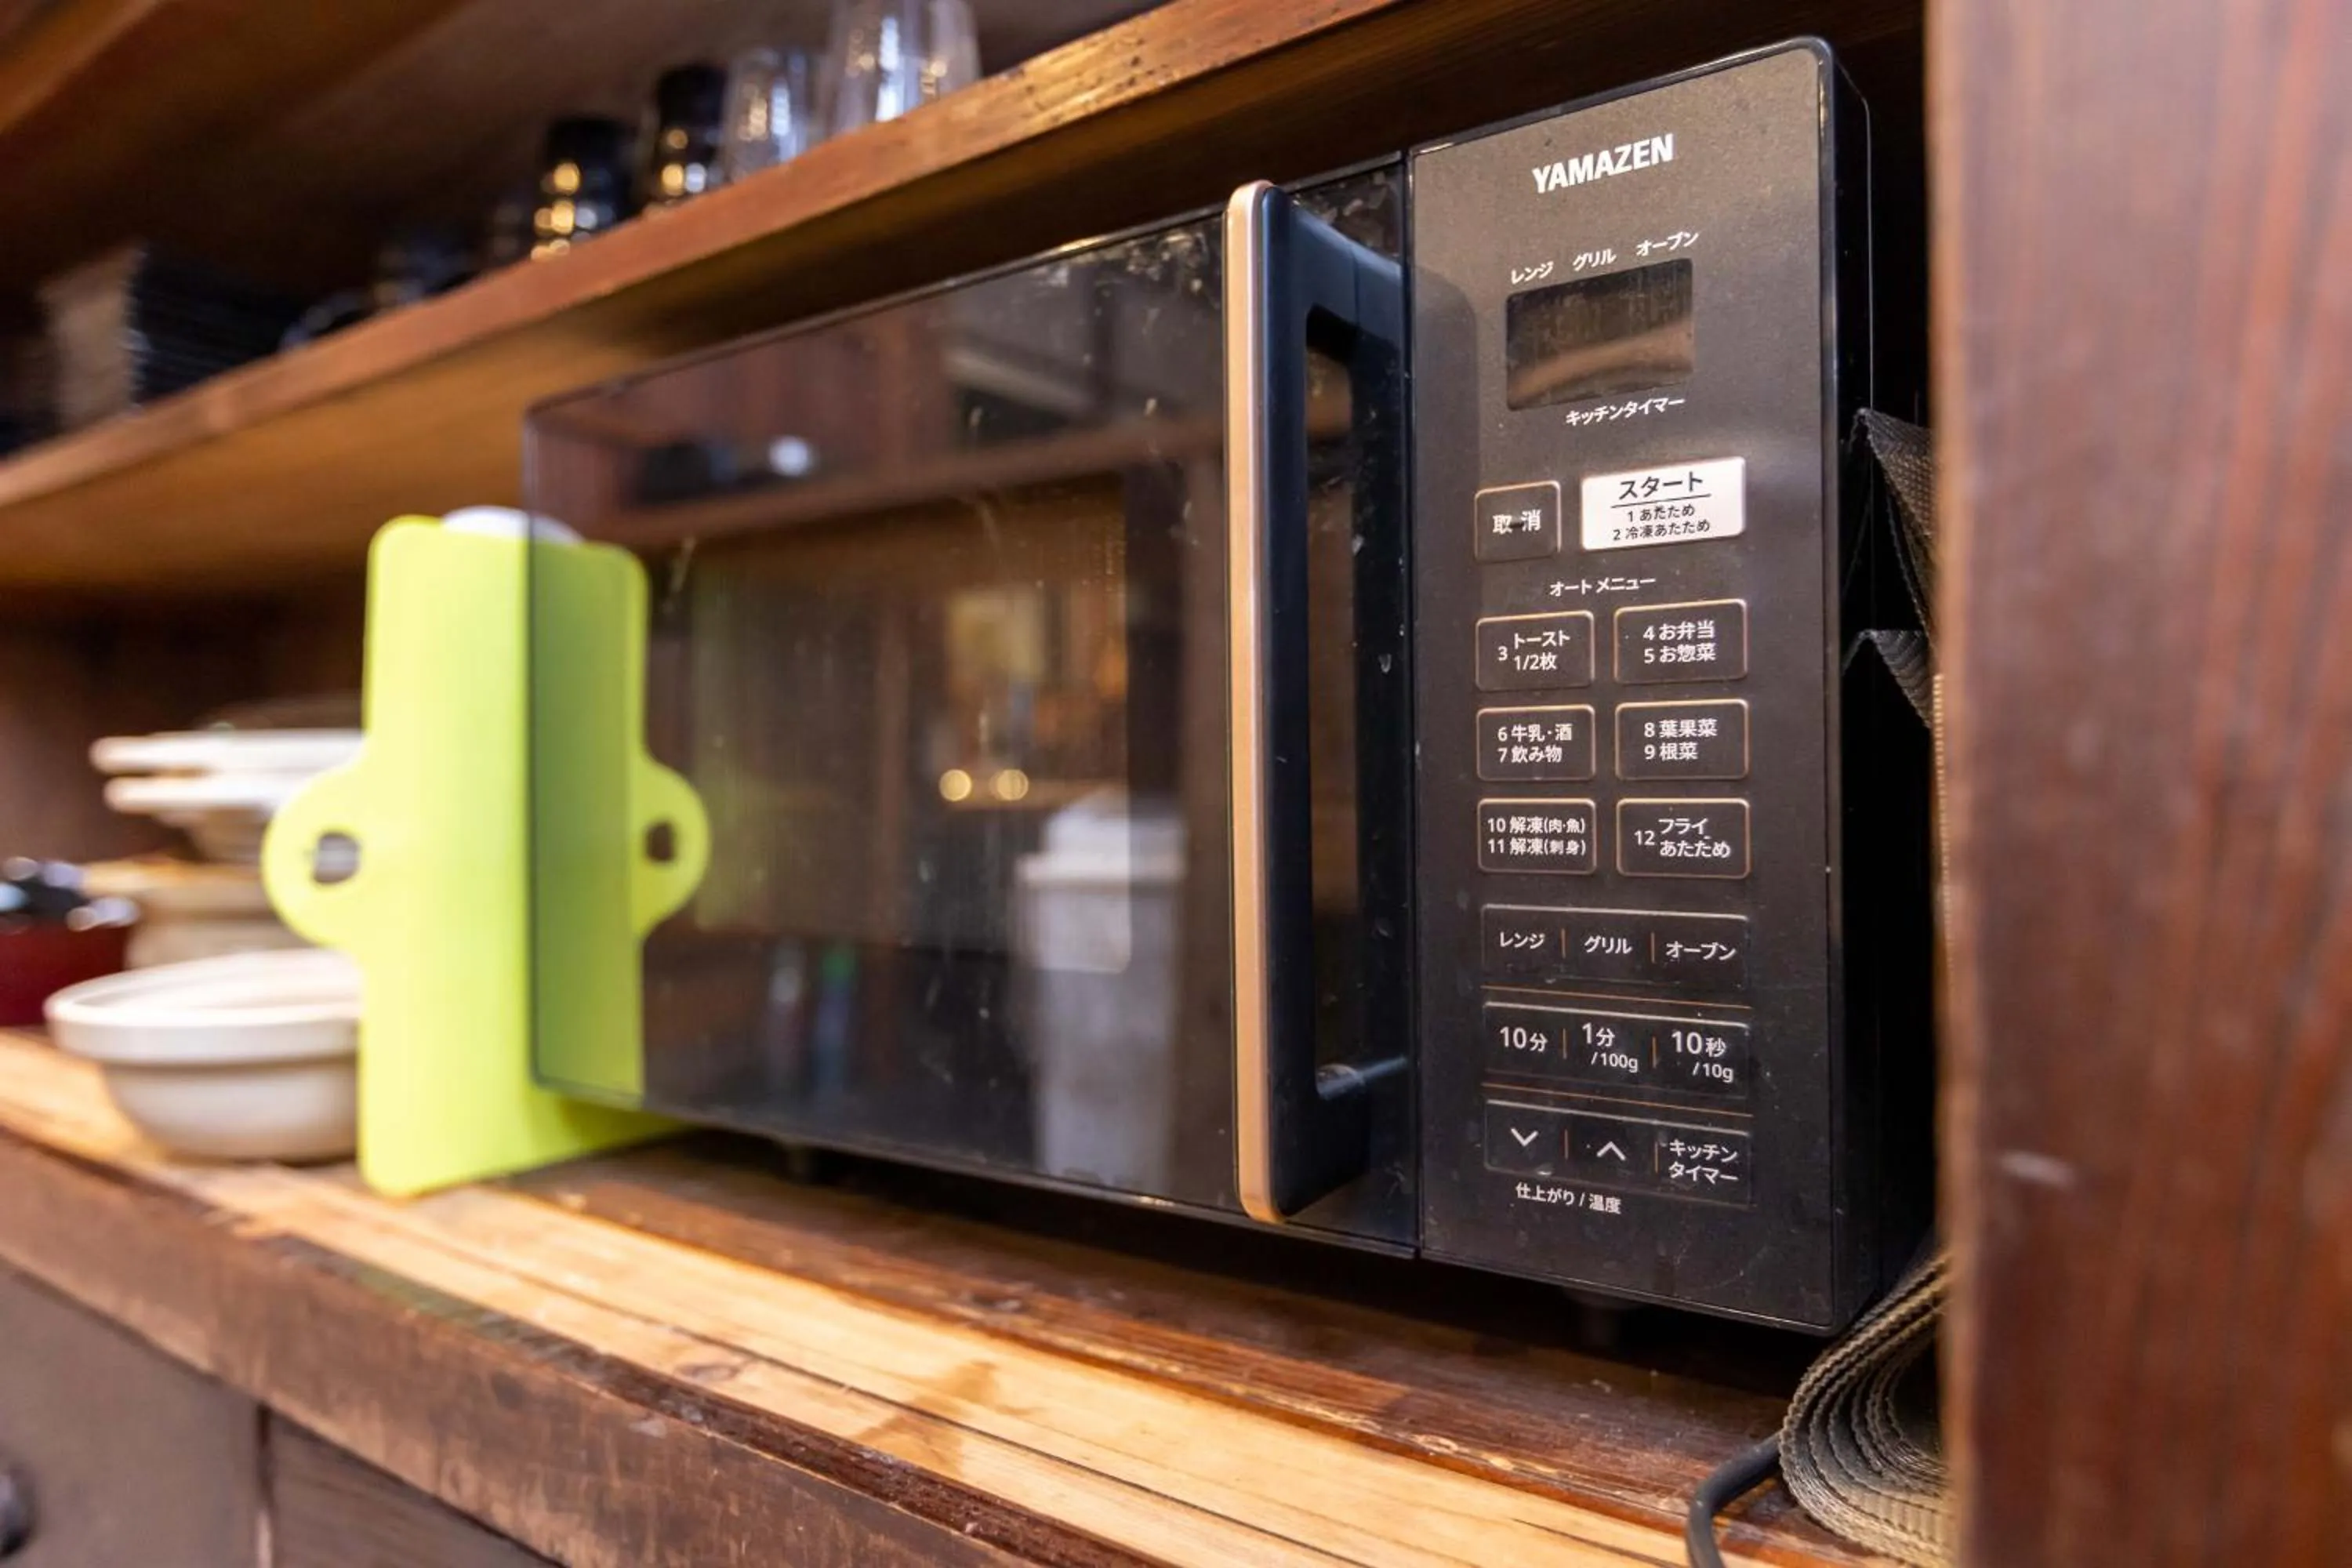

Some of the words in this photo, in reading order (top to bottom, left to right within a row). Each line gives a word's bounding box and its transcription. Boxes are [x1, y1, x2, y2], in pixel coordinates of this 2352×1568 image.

[1532, 132, 1674, 194] YAMAZEN
[1511, 260, 1554, 285] レンジ
[1572, 249, 1617, 272] グリル
[1566, 396, 1686, 426] キッチンタイマー
[1618, 471, 1704, 500] スタート
[1628, 510, 1634, 523] 1
[1639, 505, 1696, 522] あたため
[1613, 528, 1621, 541] 2
[1625, 521, 1711, 540] 冷凍あたため
[1643, 626, 1655, 641] 4
[1658, 620, 1715, 641] お弁当
[1498, 647, 1508, 662] 3
[1513, 630, 1570, 648] トースト
[1644, 648, 1654, 664] 5
[1498, 727, 1508, 742] 6
[1644, 722, 1655, 738] 8
[1659, 718, 1719, 739] 葉果菜
[1498, 749, 1507, 764] 7
[1511, 746, 1563, 764] 飲み物
[1644, 744, 1655, 760] 9
[1659, 742, 1698, 761] 根菜
[1487, 818, 1506, 833] 10
[1634, 830, 1655, 846] 12
[1658, 818, 1709, 837] フライ
[1487, 838, 1505, 855] 11
[1660, 840, 1731, 858] あたため
[1499, 931, 1545, 949] レンジ
[1584, 935, 1633, 955] グリル
[1665, 942, 1737, 961] オーブン
[1668, 1139, 1738, 1163] キッチン
[1668, 1161, 1738, 1185] タイマー
